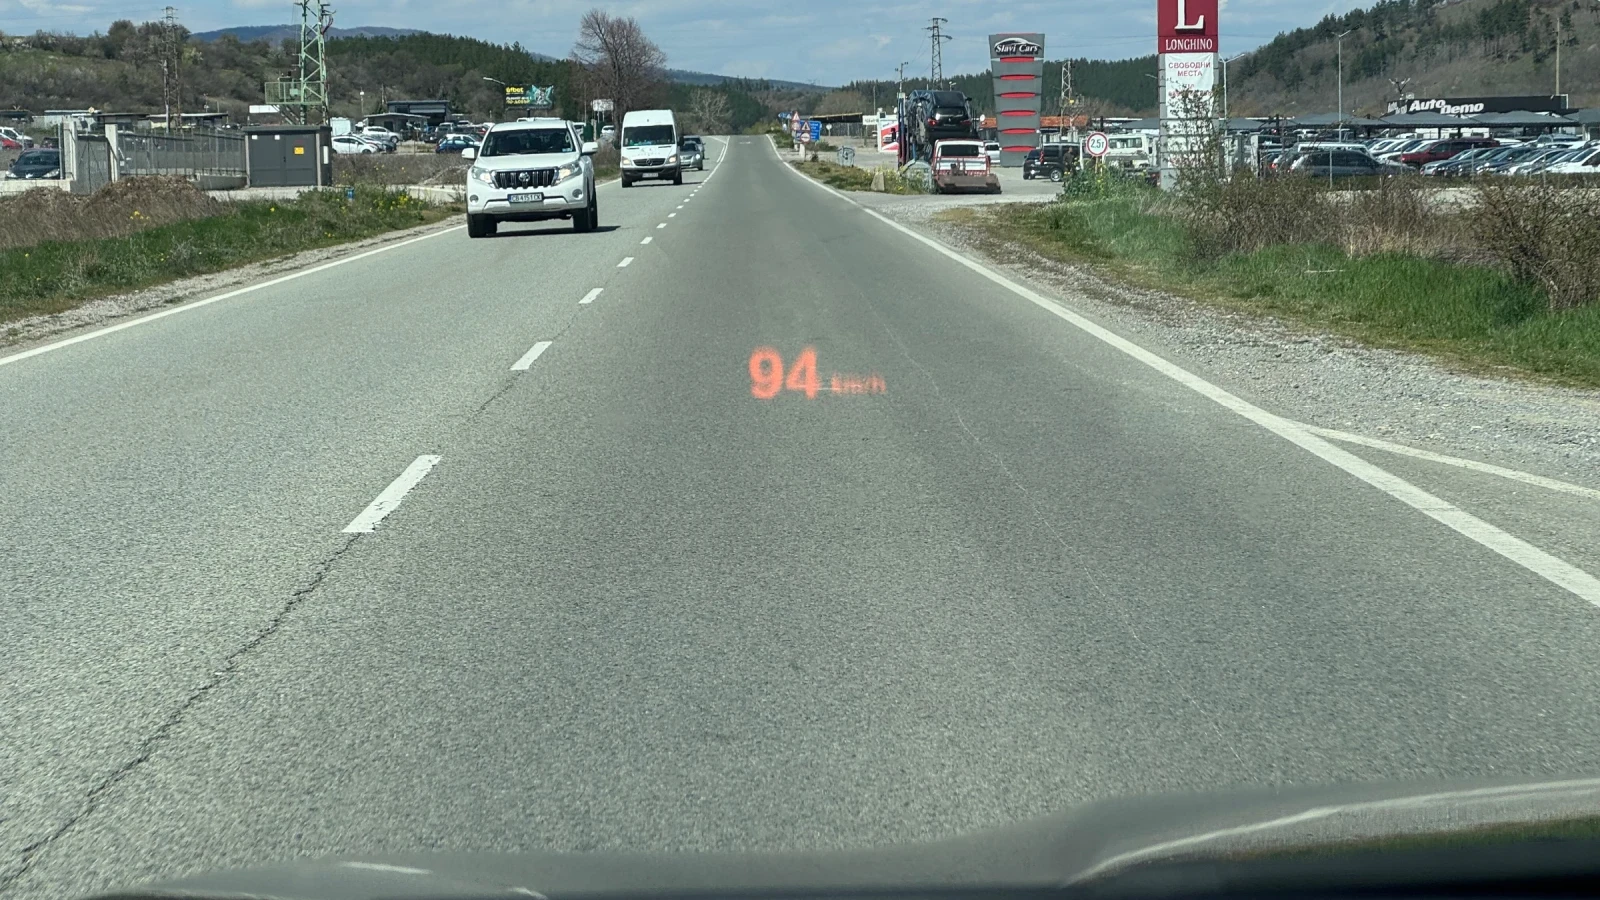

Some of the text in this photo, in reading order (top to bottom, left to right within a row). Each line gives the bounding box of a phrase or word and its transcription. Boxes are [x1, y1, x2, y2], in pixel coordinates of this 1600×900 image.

[1174, 0, 1204, 29] L
[995, 44, 1038, 52] Slavi Cars
[1165, 38, 1213, 50] LONGHINO
[1168, 61, 1211, 69] СВОБОДНИ
[1408, 99, 1446, 112] Auto
[1440, 104, 1484, 114] Demo
[749, 345, 820, 400] 94
